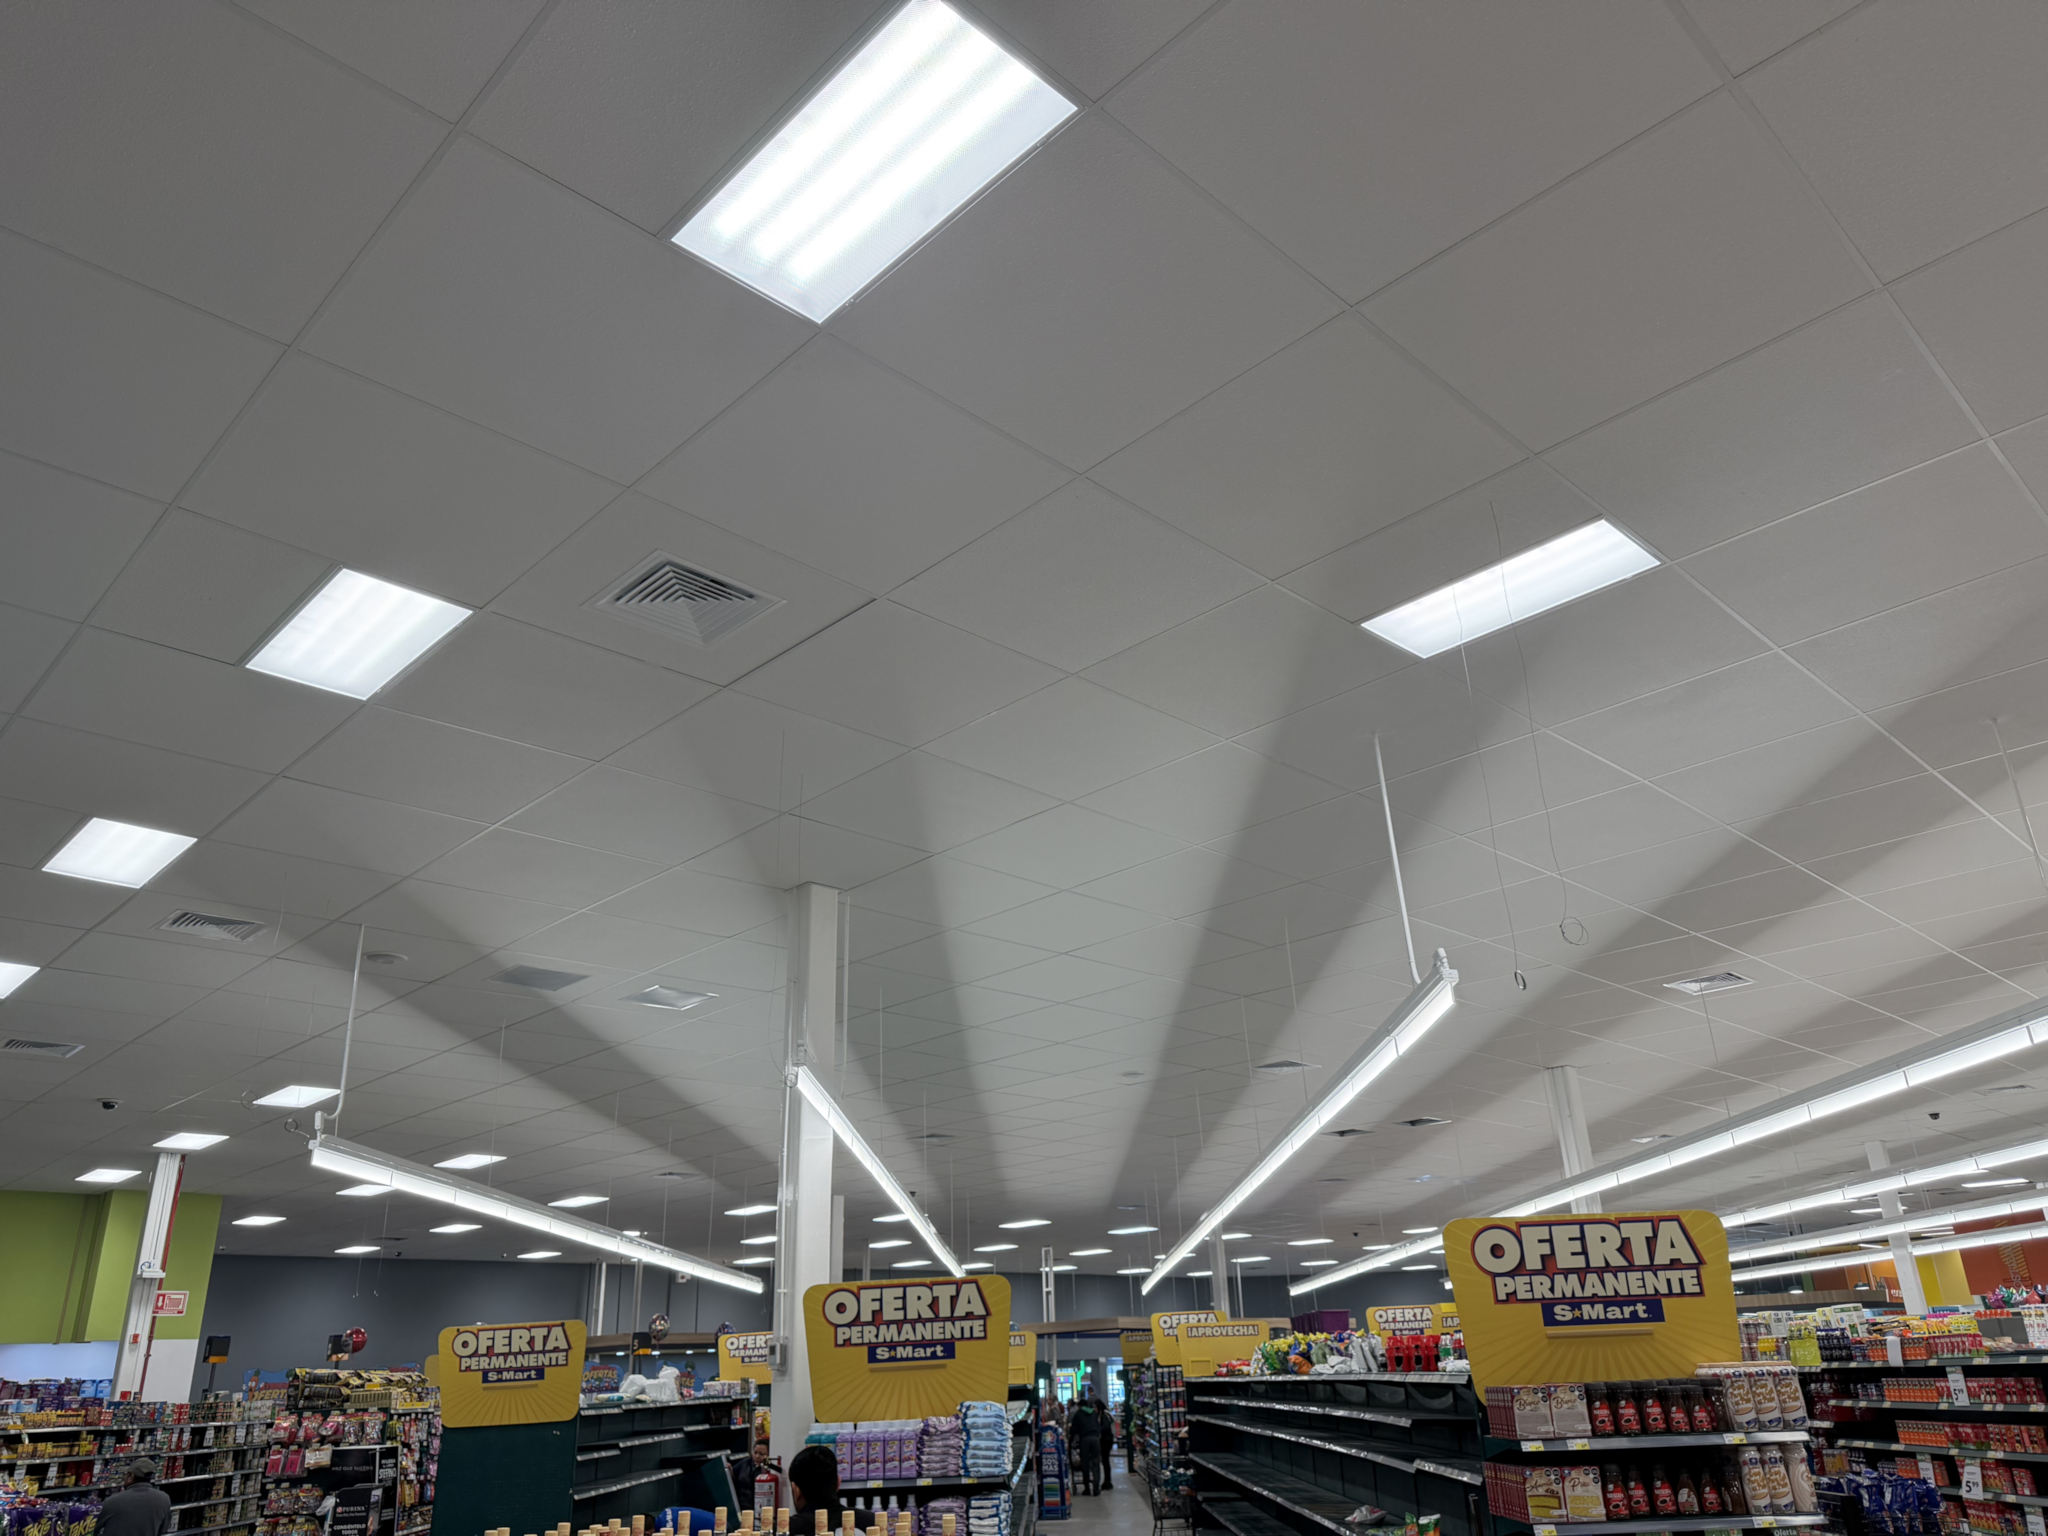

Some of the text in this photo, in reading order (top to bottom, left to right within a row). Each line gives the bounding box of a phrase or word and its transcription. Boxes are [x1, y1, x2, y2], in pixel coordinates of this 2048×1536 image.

[1472, 1219, 1701, 1274] OFERTA
[1494, 1268, 1702, 1302] PERMANENTE
[824, 1281, 988, 1326] OFERTA
[1159, 1312, 1218, 1329] OFERTA
[1374, 1307, 1433, 1323] OFERTA
[1442, 1316, 1460, 1327] ¡AP
[836, 1318, 986, 1346] PERMANENTE
[1187, 1324, 1258, 1337] ¡APROVECHA!
[452, 1325, 569, 1357] OFERTA
[460, 1352, 567, 1371] PERMANENTE
[582, 1370, 618, 1382] OFERTAS
